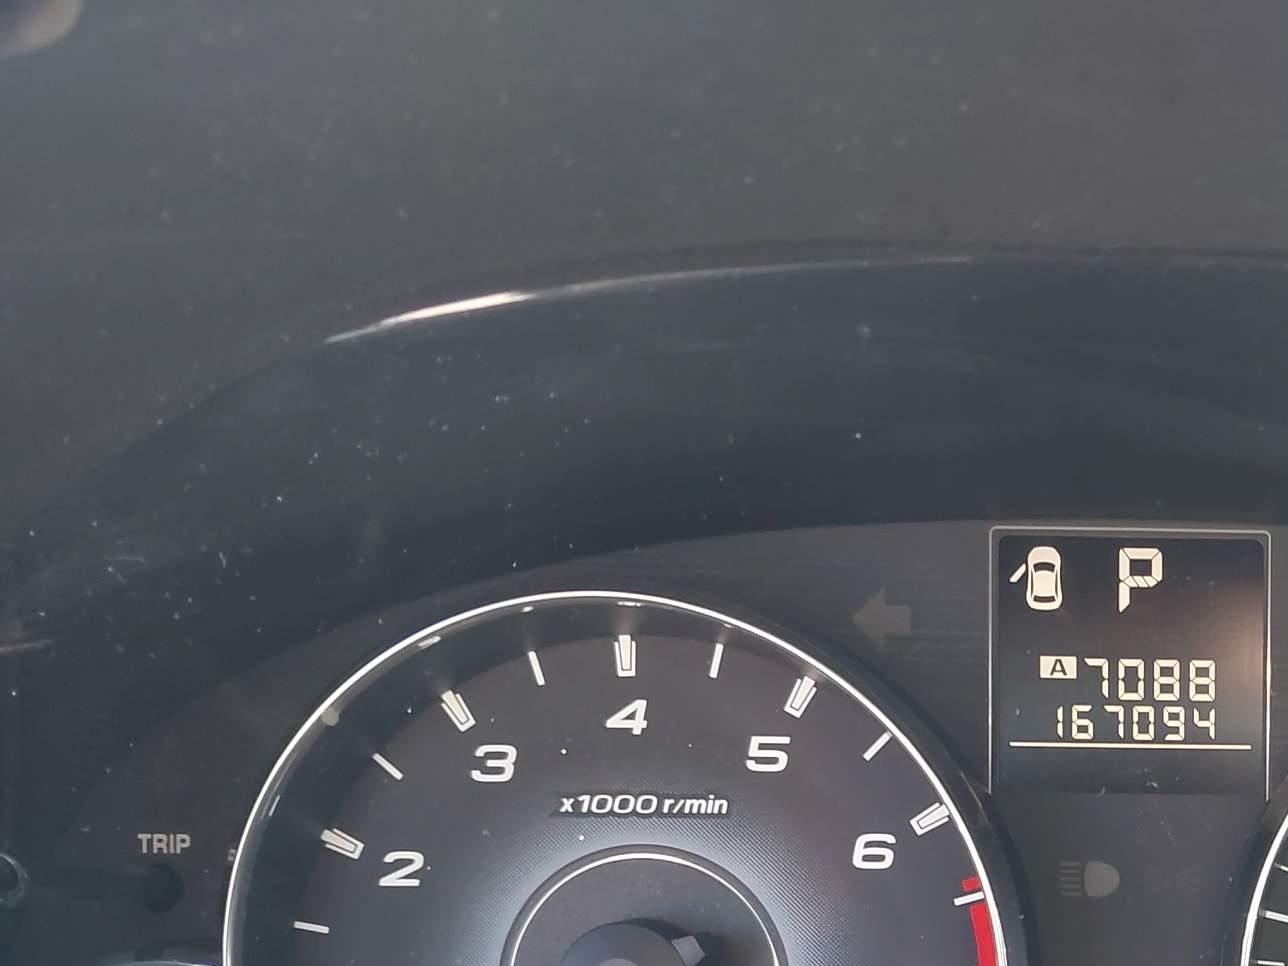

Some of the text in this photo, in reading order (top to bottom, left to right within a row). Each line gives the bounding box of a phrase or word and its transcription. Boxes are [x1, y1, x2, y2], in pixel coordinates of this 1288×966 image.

[1118, 547, 1163, 613] P
[1049, 658, 1216, 702] A 7088
[605, 698, 648, 735] 4
[1056, 704, 1216, 742] 167094
[470, 744, 518, 783] 3
[745, 735, 791, 772] 5
[558, 792, 729, 819] x1000 r/min
[137, 833, 192, 855] TRIP
[850, 833, 896, 871] 6
[378, 850, 425, 888] 2
